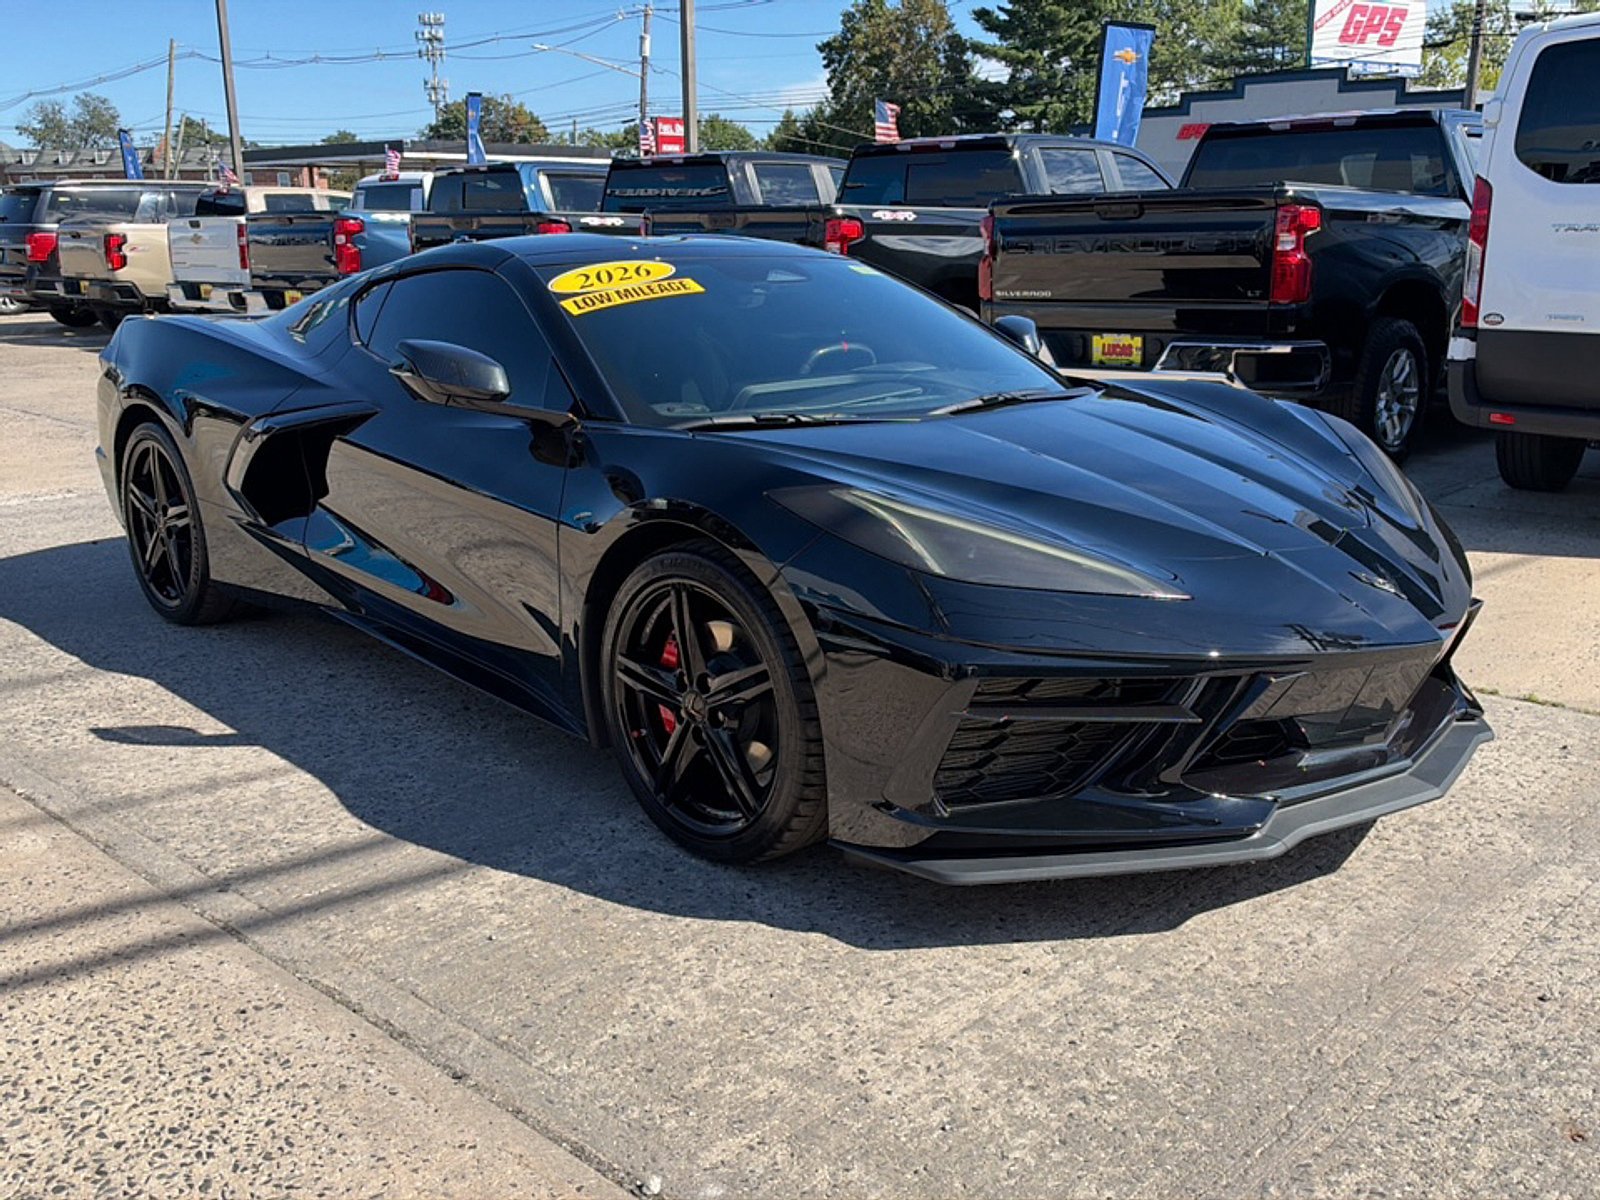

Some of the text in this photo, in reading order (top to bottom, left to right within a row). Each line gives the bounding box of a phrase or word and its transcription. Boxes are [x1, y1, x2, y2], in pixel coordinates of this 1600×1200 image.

[1339, 4, 1408, 47] GPS
[576, 263, 651, 289] 2026
[573, 280, 692, 310] LOW MILEAGE
[994, 290, 1052, 298] SILVERADO
[1246, 289, 1263, 297] LT
[1102, 343, 1133, 358] LUCAS
